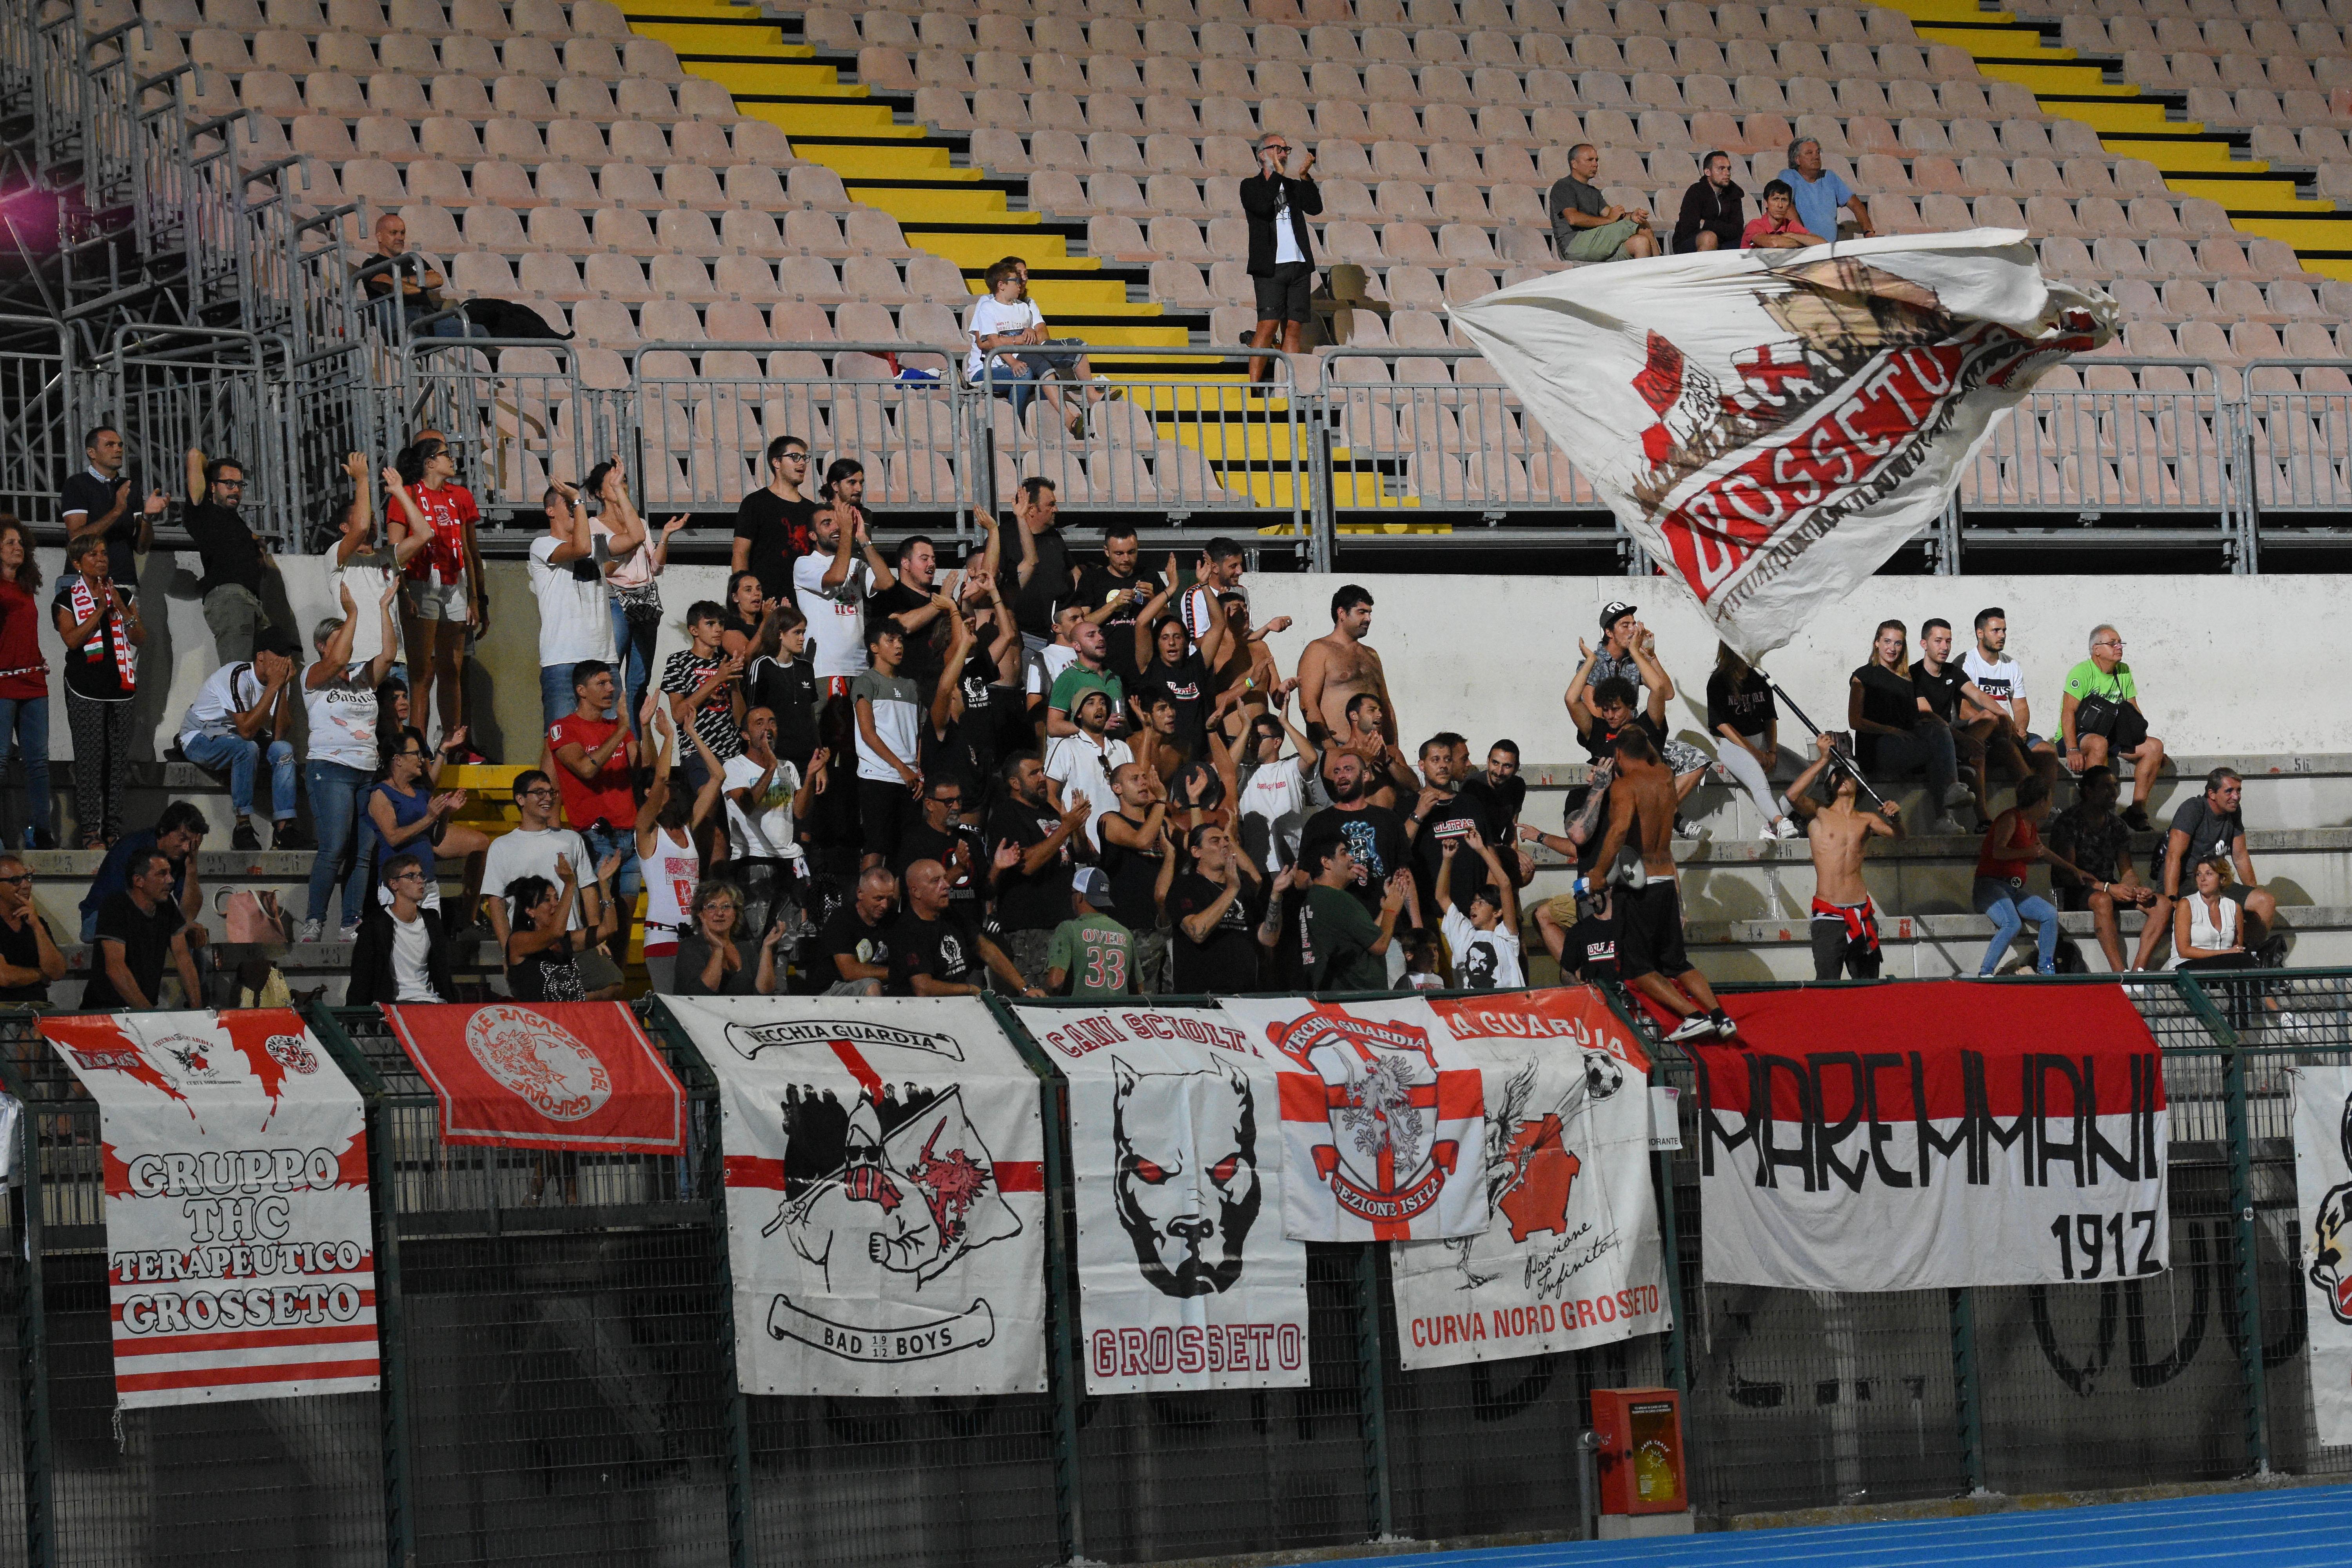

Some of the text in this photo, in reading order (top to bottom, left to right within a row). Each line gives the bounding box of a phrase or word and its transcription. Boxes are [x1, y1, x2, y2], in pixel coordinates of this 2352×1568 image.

[1433, 819, 1476, 833] ULTRAS
[1082, 929, 1127, 947] OVER
[1085, 946, 1125, 990] 33
[744, 1023, 937, 1050] VECCHIA GUARDIA
[1046, 1016, 1130, 1058] CANI
[1338, 1019, 1426, 1051] GUARDIA
[1479, 1010, 1628, 1061] GUARDIA
[588, 1067, 608, 1092] DEL
[1683, 1044, 2158, 1193] MAREMMANI
[128, 1147, 339, 1199] GRUPPO
[1334, 1176, 1441, 1217] SEZIONE ISTIA
[183, 1196, 290, 1242] THC
[113, 1240, 362, 1283] TERAPEUTICO
[2050, 1210, 2163, 1280] 1912
[122, 1283, 361, 1334] GROSSETO
[1411, 1284, 1659, 1348] CURVA NORD GROSSETO
[824, 1327, 862, 1354] BAD
[896, 1327, 953, 1356] BOYS
[1092, 1323, 1301, 1377] GROSSETO
[1641, 1440, 1653, 1454] SAFE
